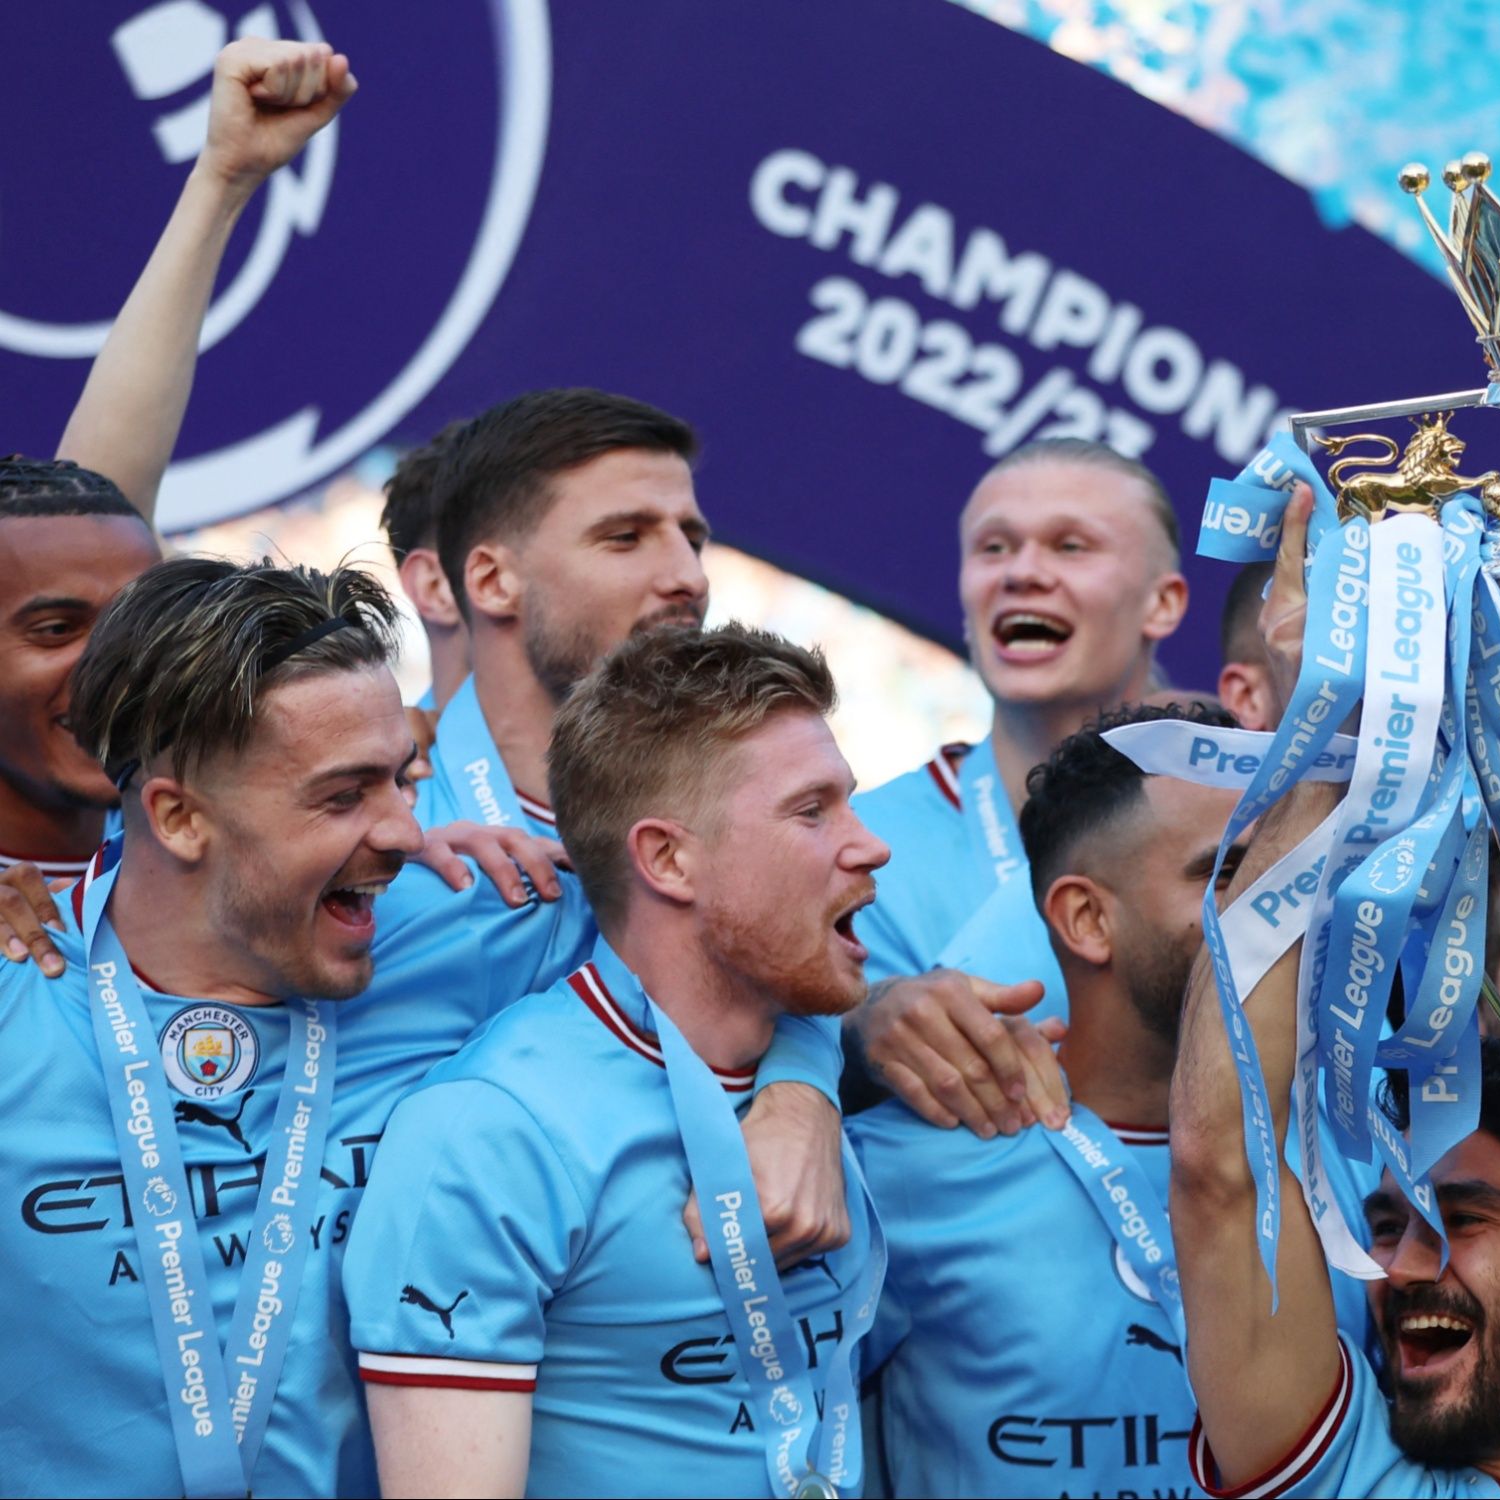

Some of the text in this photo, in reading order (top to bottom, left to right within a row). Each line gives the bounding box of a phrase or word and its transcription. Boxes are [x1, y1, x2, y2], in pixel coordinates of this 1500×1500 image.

[1202, 501, 1282, 550] Prem
[1233, 524, 1369, 822] Premier League
[1343, 541, 1434, 845] Premier League
[464, 757, 513, 828] Premi
[1188, 735, 1356, 775] Preer
[168, 1009, 250, 1042] MANCHESTER
[1328, 899, 1386, 1032] League
[1401, 894, 1475, 1049] League
[194, 1086, 225, 1098] CITY
[91, 960, 214, 1438] Premier League Premier League
[236, 1260, 283, 1368] League
[271, 1101, 312, 1207] Premier
[1100, 1166, 1162, 1264] League
[715, 1190, 757, 1293] Premier
[743, 1295, 784, 1381] League
